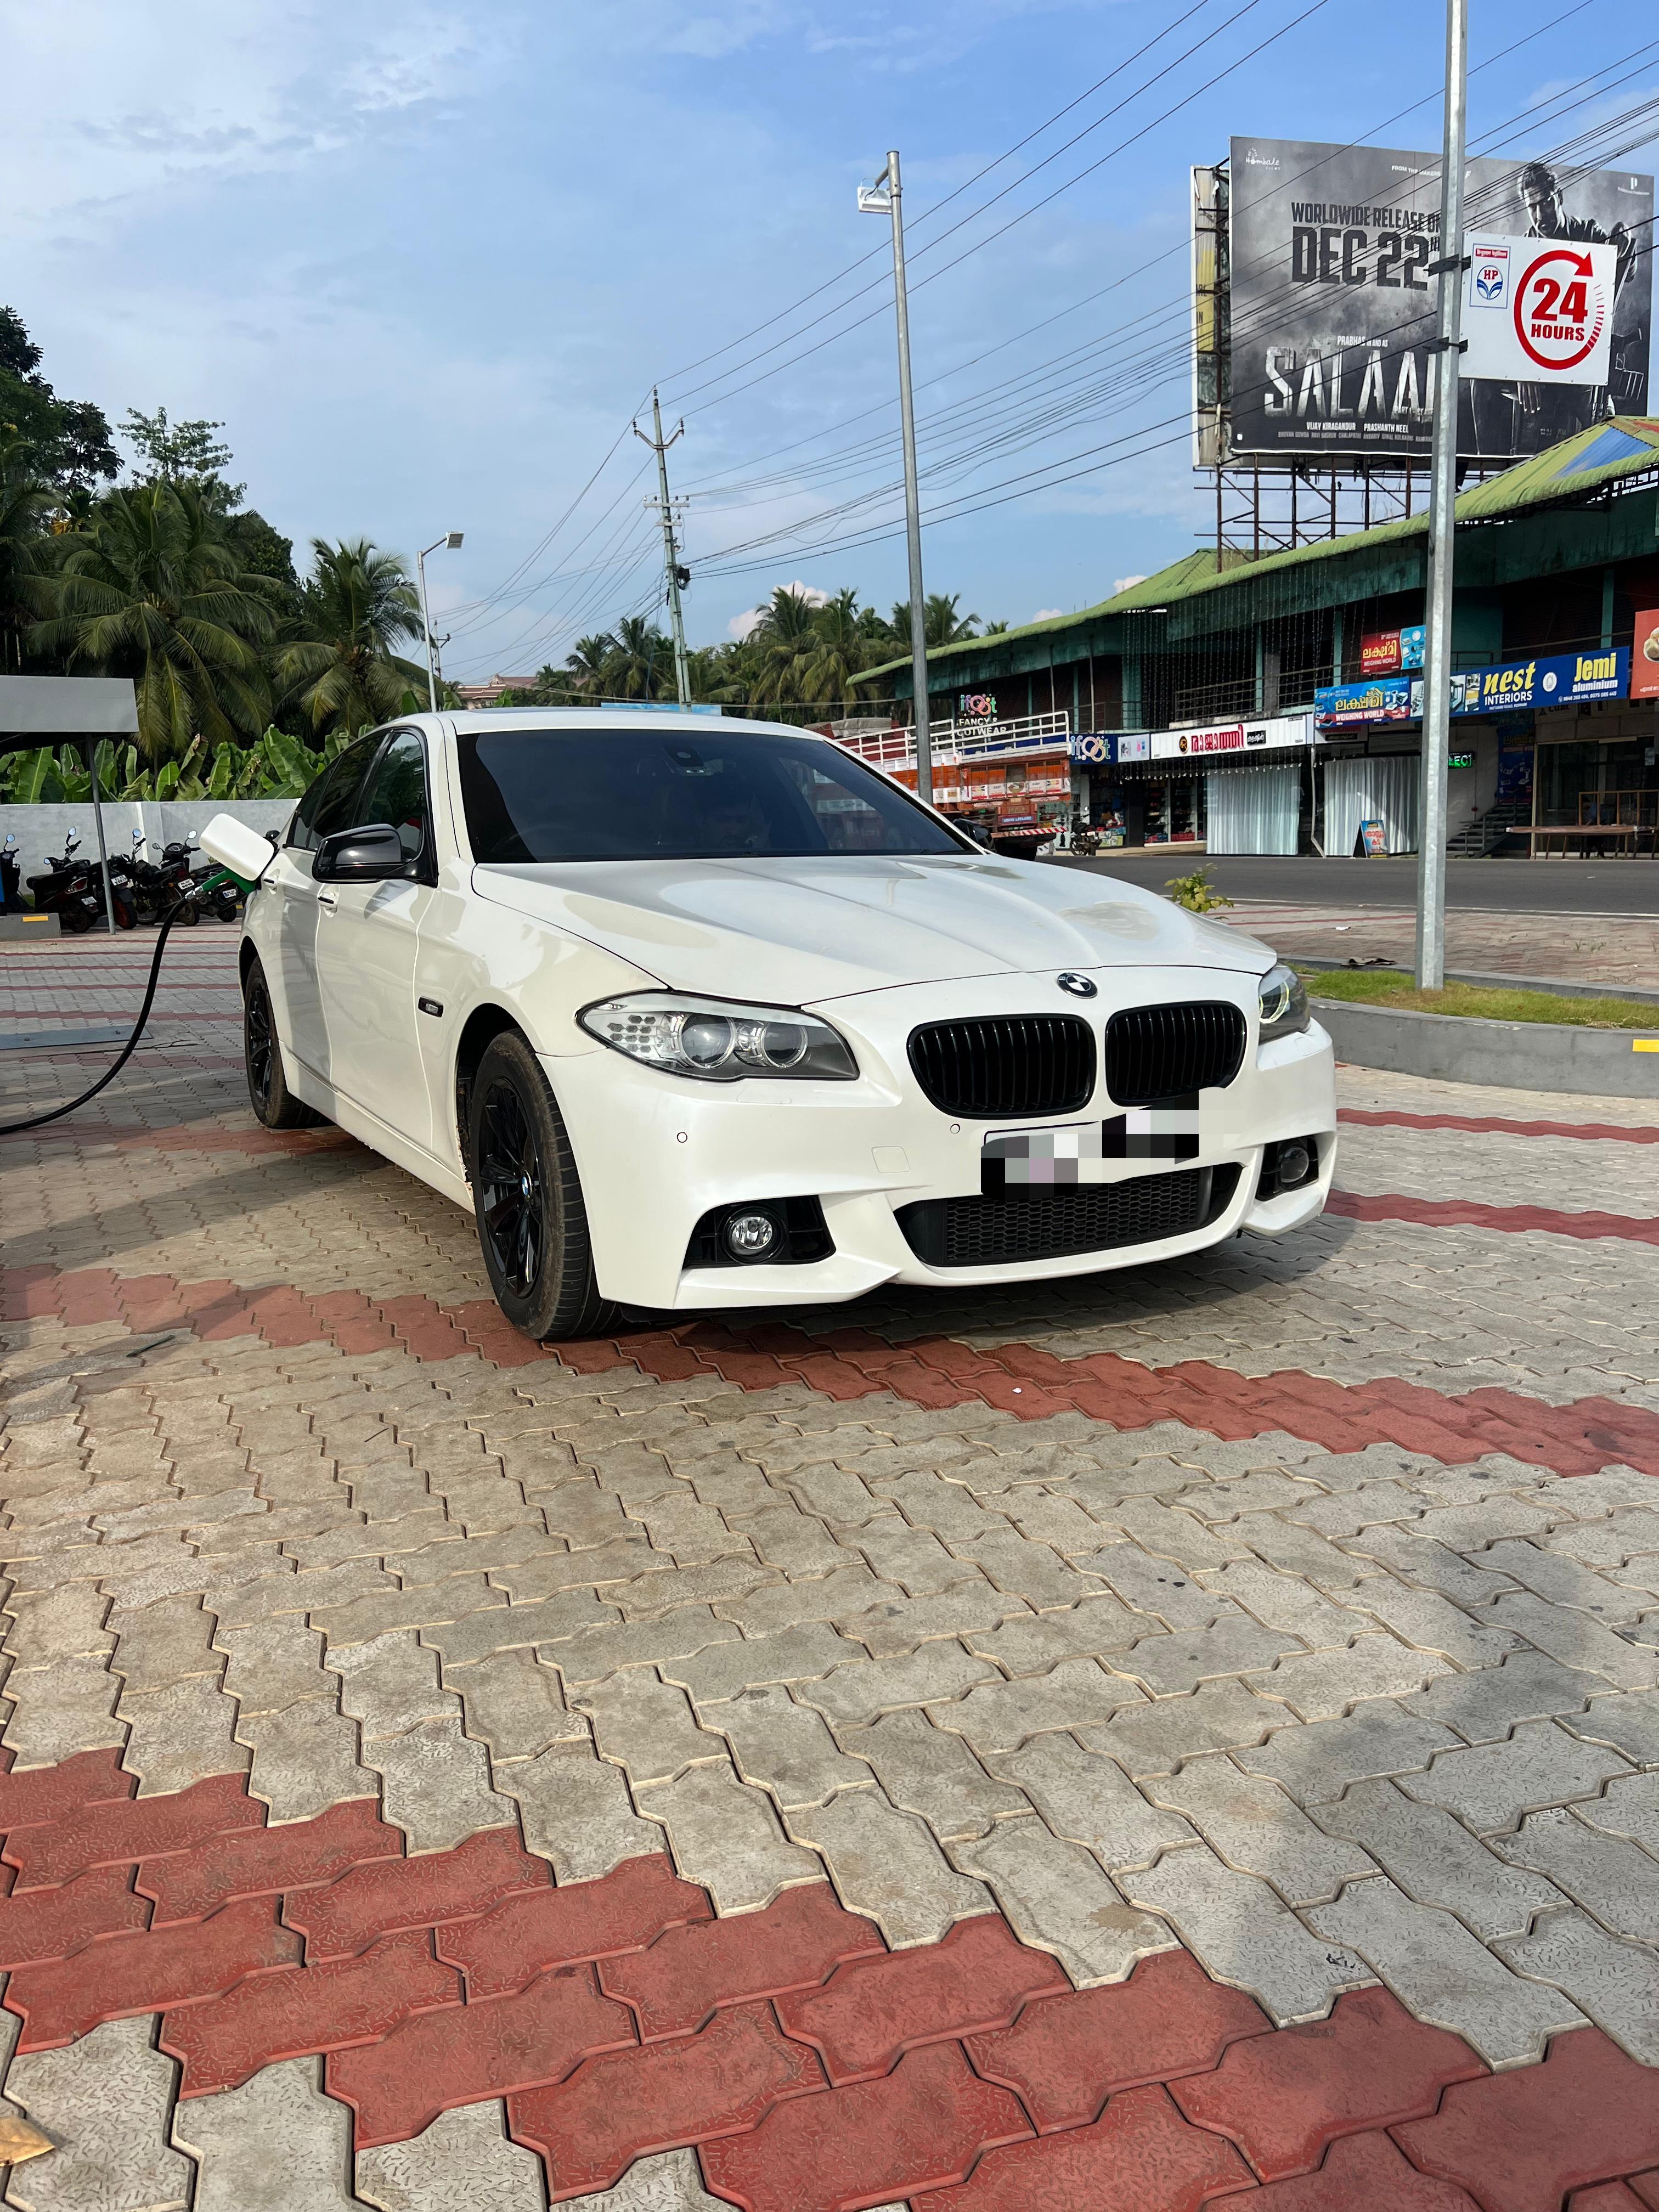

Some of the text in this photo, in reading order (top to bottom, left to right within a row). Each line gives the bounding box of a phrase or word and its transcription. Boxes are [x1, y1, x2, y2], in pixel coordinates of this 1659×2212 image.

[1291, 202, 1370, 227] WORLDWIDE
[1373, 207, 1425, 232] RELEASE
[1292, 226, 1367, 286] DEC
[1483, 269, 1499, 280] HP
[1531, 278, 1588, 324] 24
[1337, 335, 1366, 346] PRABHAS
[1531, 324, 1585, 341] HOURS
[1306, 421, 1322, 430] VIJAY
[1322, 422, 1356, 431] KIRAGANDUR
[1363, 423, 1395, 432] PRASHANTH
[1574, 652, 1617, 682] Jemi
[1483, 662, 1536, 695] nest
[1572, 679, 1618, 693] aluminium
[1485, 690, 1532, 706] INTERIORS
[959, 717, 990, 726] FANCY
[1335, 711, 1363, 722] WEIGHING
[1363, 709, 1385, 719] WORLD
